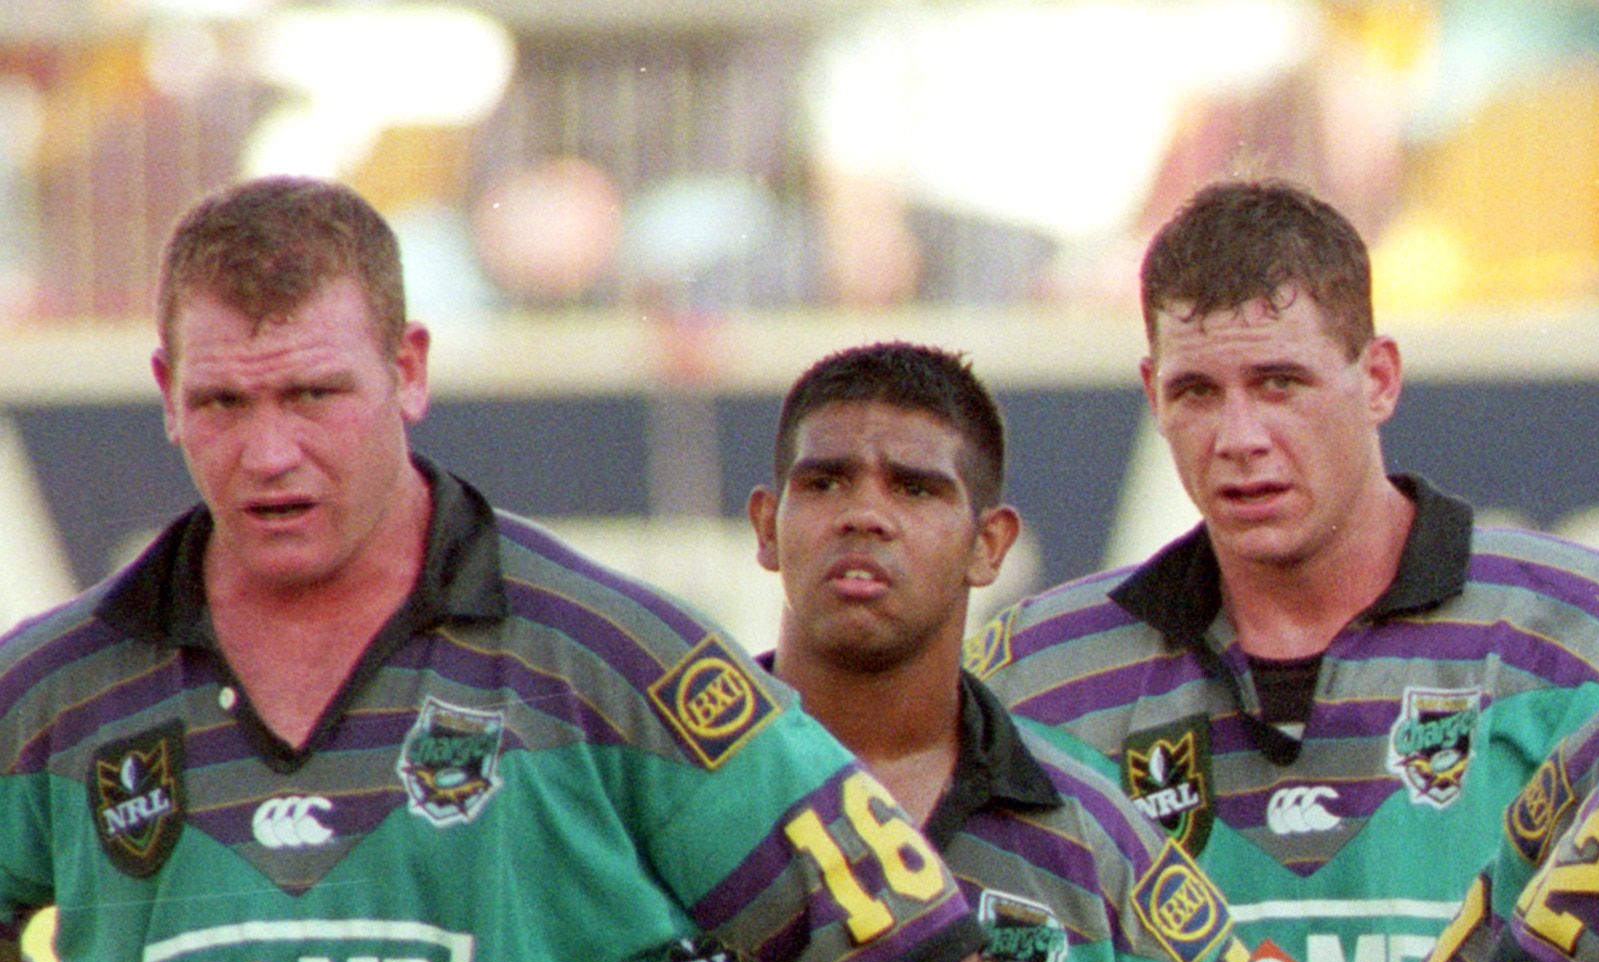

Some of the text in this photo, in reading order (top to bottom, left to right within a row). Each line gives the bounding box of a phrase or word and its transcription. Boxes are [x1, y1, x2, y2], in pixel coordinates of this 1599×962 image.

[102, 788, 171, 834] NRL
[1133, 783, 1199, 818] NRL
[785, 769, 945, 944] 16
